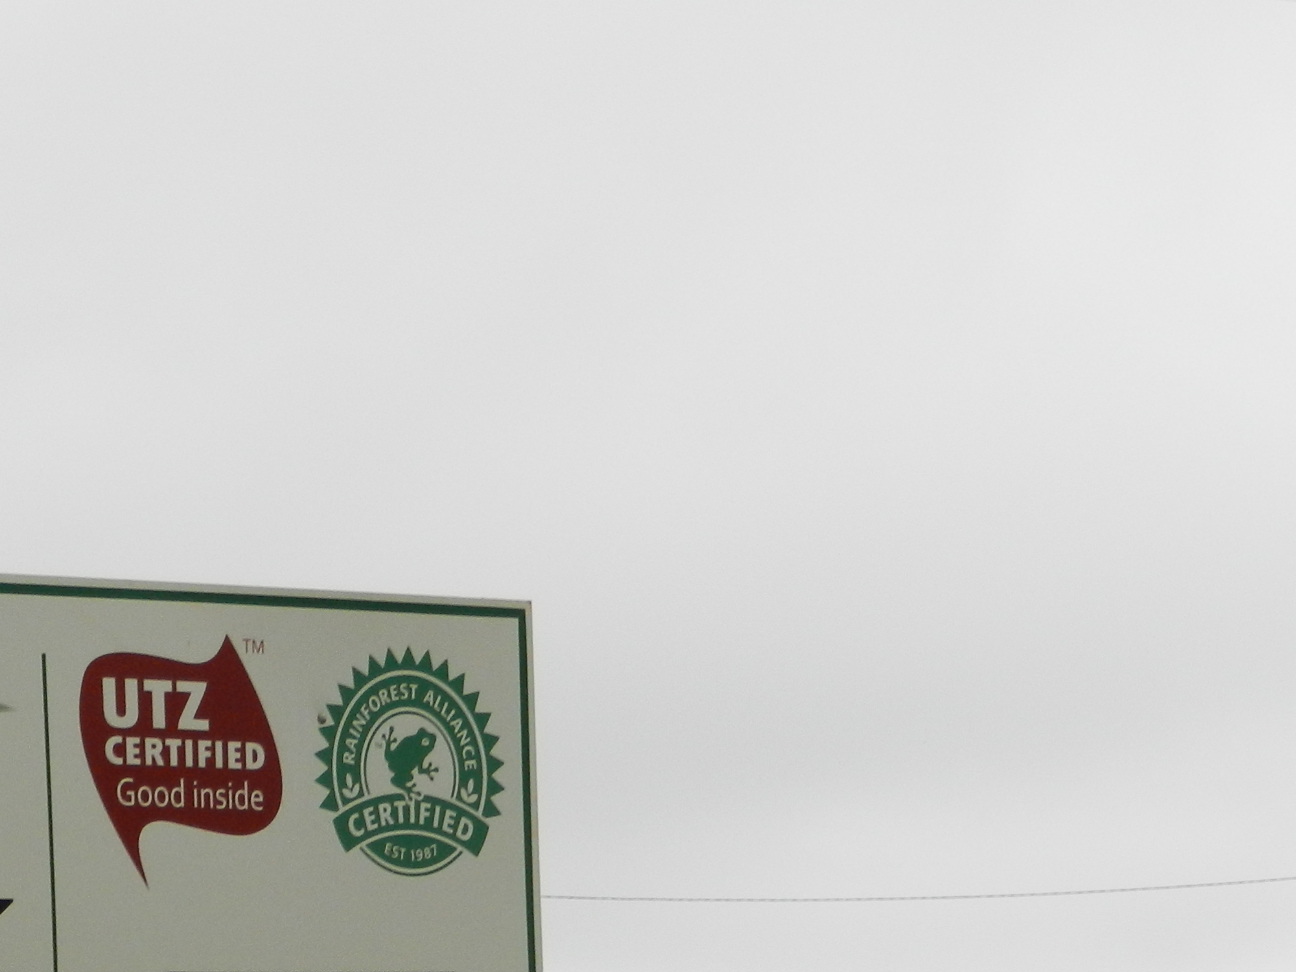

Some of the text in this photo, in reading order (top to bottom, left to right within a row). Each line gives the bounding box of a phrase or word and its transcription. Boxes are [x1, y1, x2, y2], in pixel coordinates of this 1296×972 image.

[102, 676, 210, 731] UTZ
[343, 683, 477, 771] RAINFOREST ALLIANCE
[105, 735, 265, 770] CERTIFIED
[117, 777, 264, 811] Good inside
[347, 800, 474, 842] CERTIFIED
[384, 842, 438, 862] EST 1987
